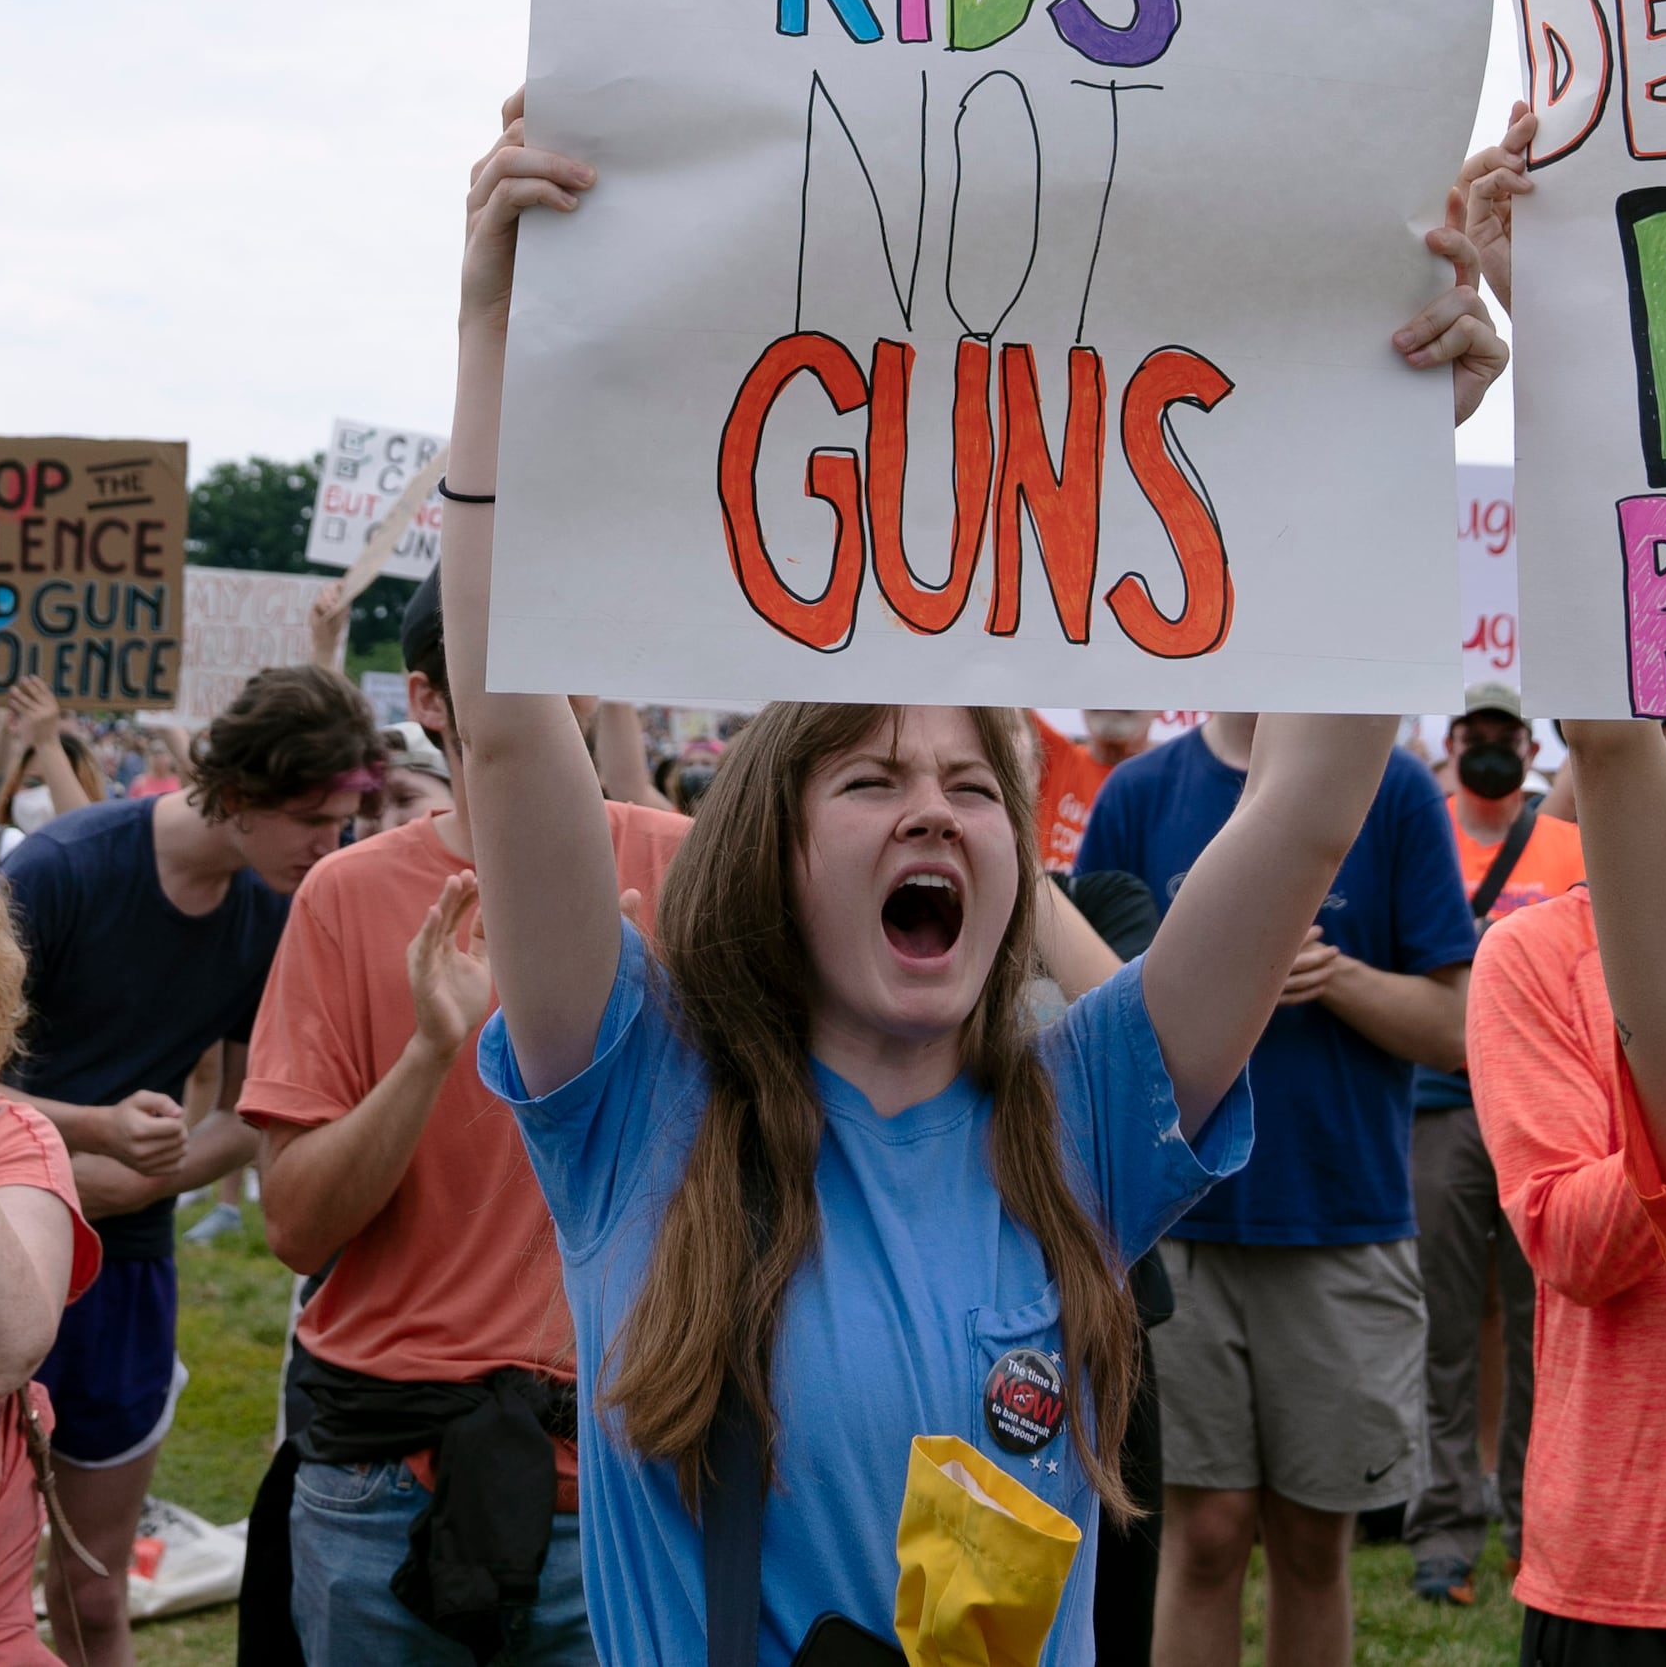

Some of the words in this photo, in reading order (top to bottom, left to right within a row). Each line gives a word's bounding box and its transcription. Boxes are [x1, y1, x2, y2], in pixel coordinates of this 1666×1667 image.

[795, 69, 1164, 342] NOT
[94, 472, 145, 496] THE
[717, 330, 1236, 660] GUNS
[32, 578, 169, 638] GUN
[989, 1371, 1063, 1427] NOW
[1007, 1358, 1026, 1377] The
[1027, 1368, 1050, 1389] time
[1051, 1379, 1061, 1394] is
[992, 1402, 1001, 1414] to
[1002, 1407, 1019, 1423] ban
[1019, 1417, 1050, 1439] assault
[997, 1419, 1038, 1445] weapons!
